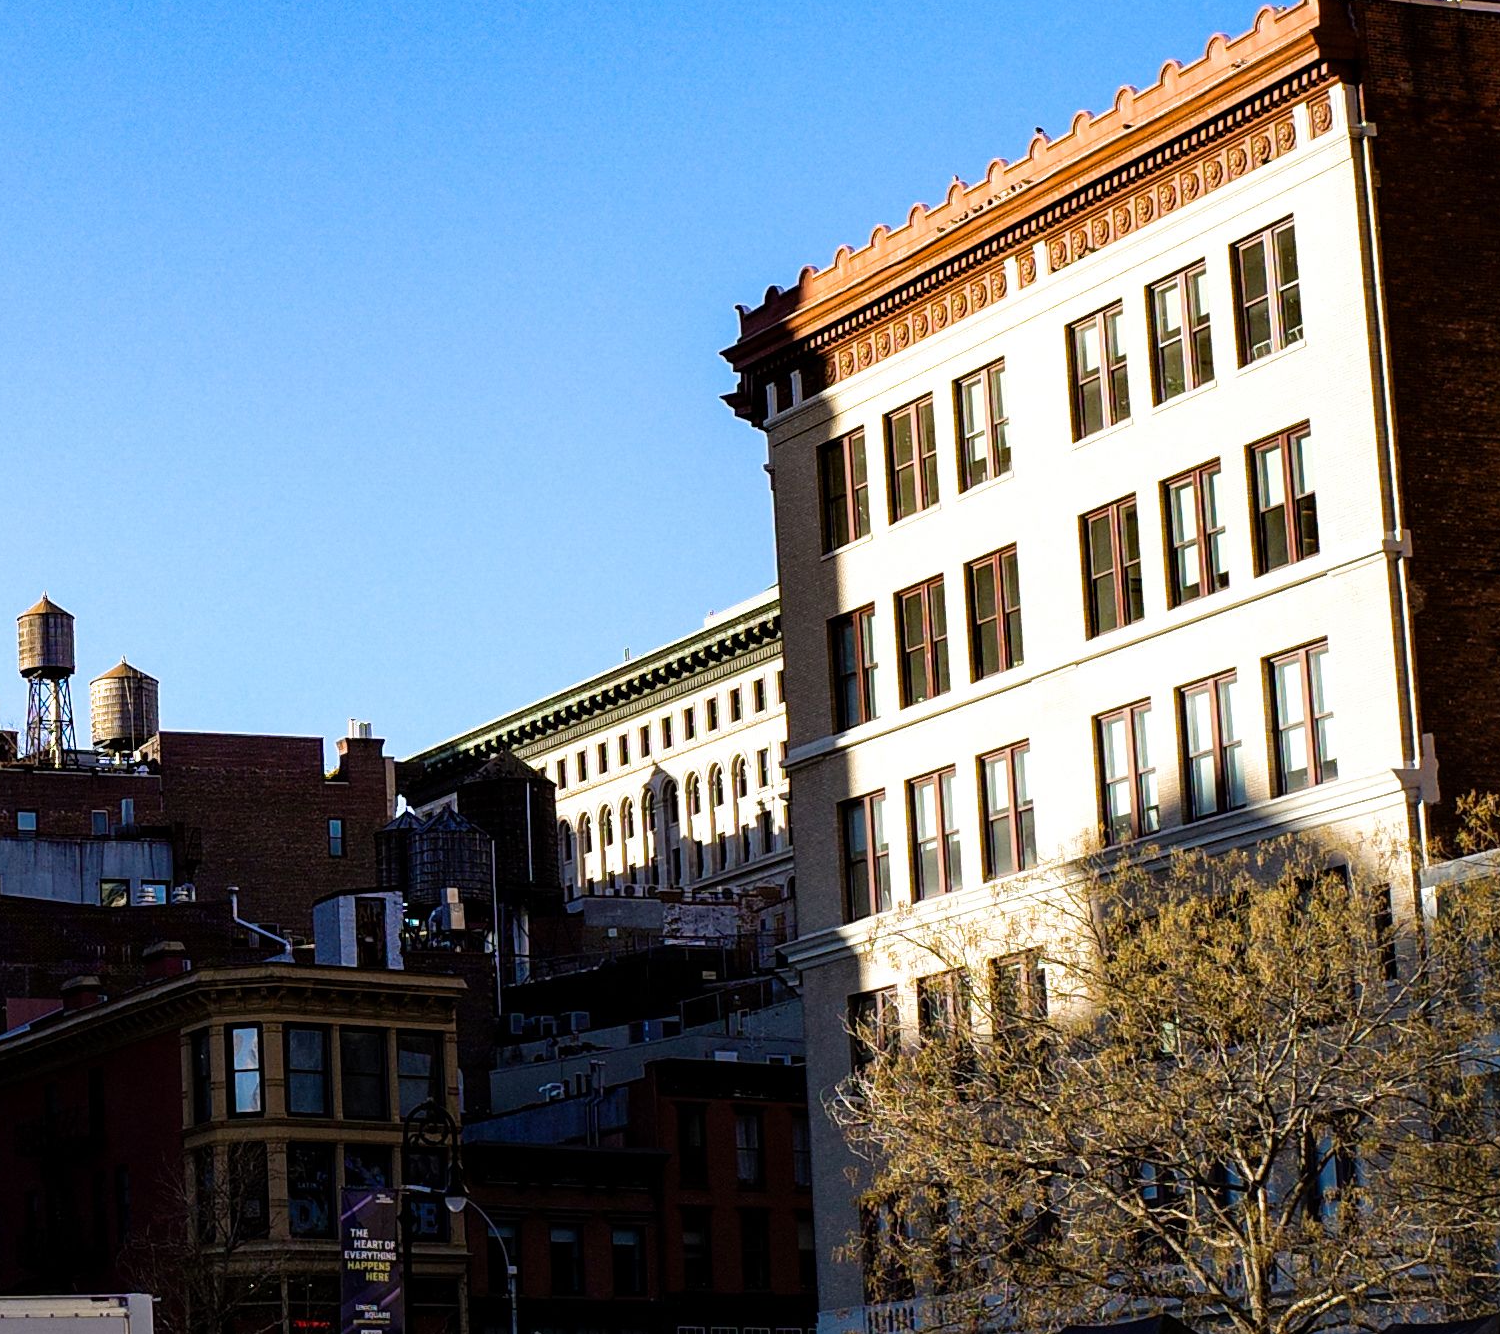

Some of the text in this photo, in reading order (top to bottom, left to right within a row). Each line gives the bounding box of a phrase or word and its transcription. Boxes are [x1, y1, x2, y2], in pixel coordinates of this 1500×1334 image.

[350, 1228, 368, 1238] THE
[354, 1240, 396, 1250] HEART OF
[344, 1251, 396, 1261] EVERYTHING
[347, 1261, 391, 1271] HAPPENS
[365, 1271, 390, 1282] HERE
